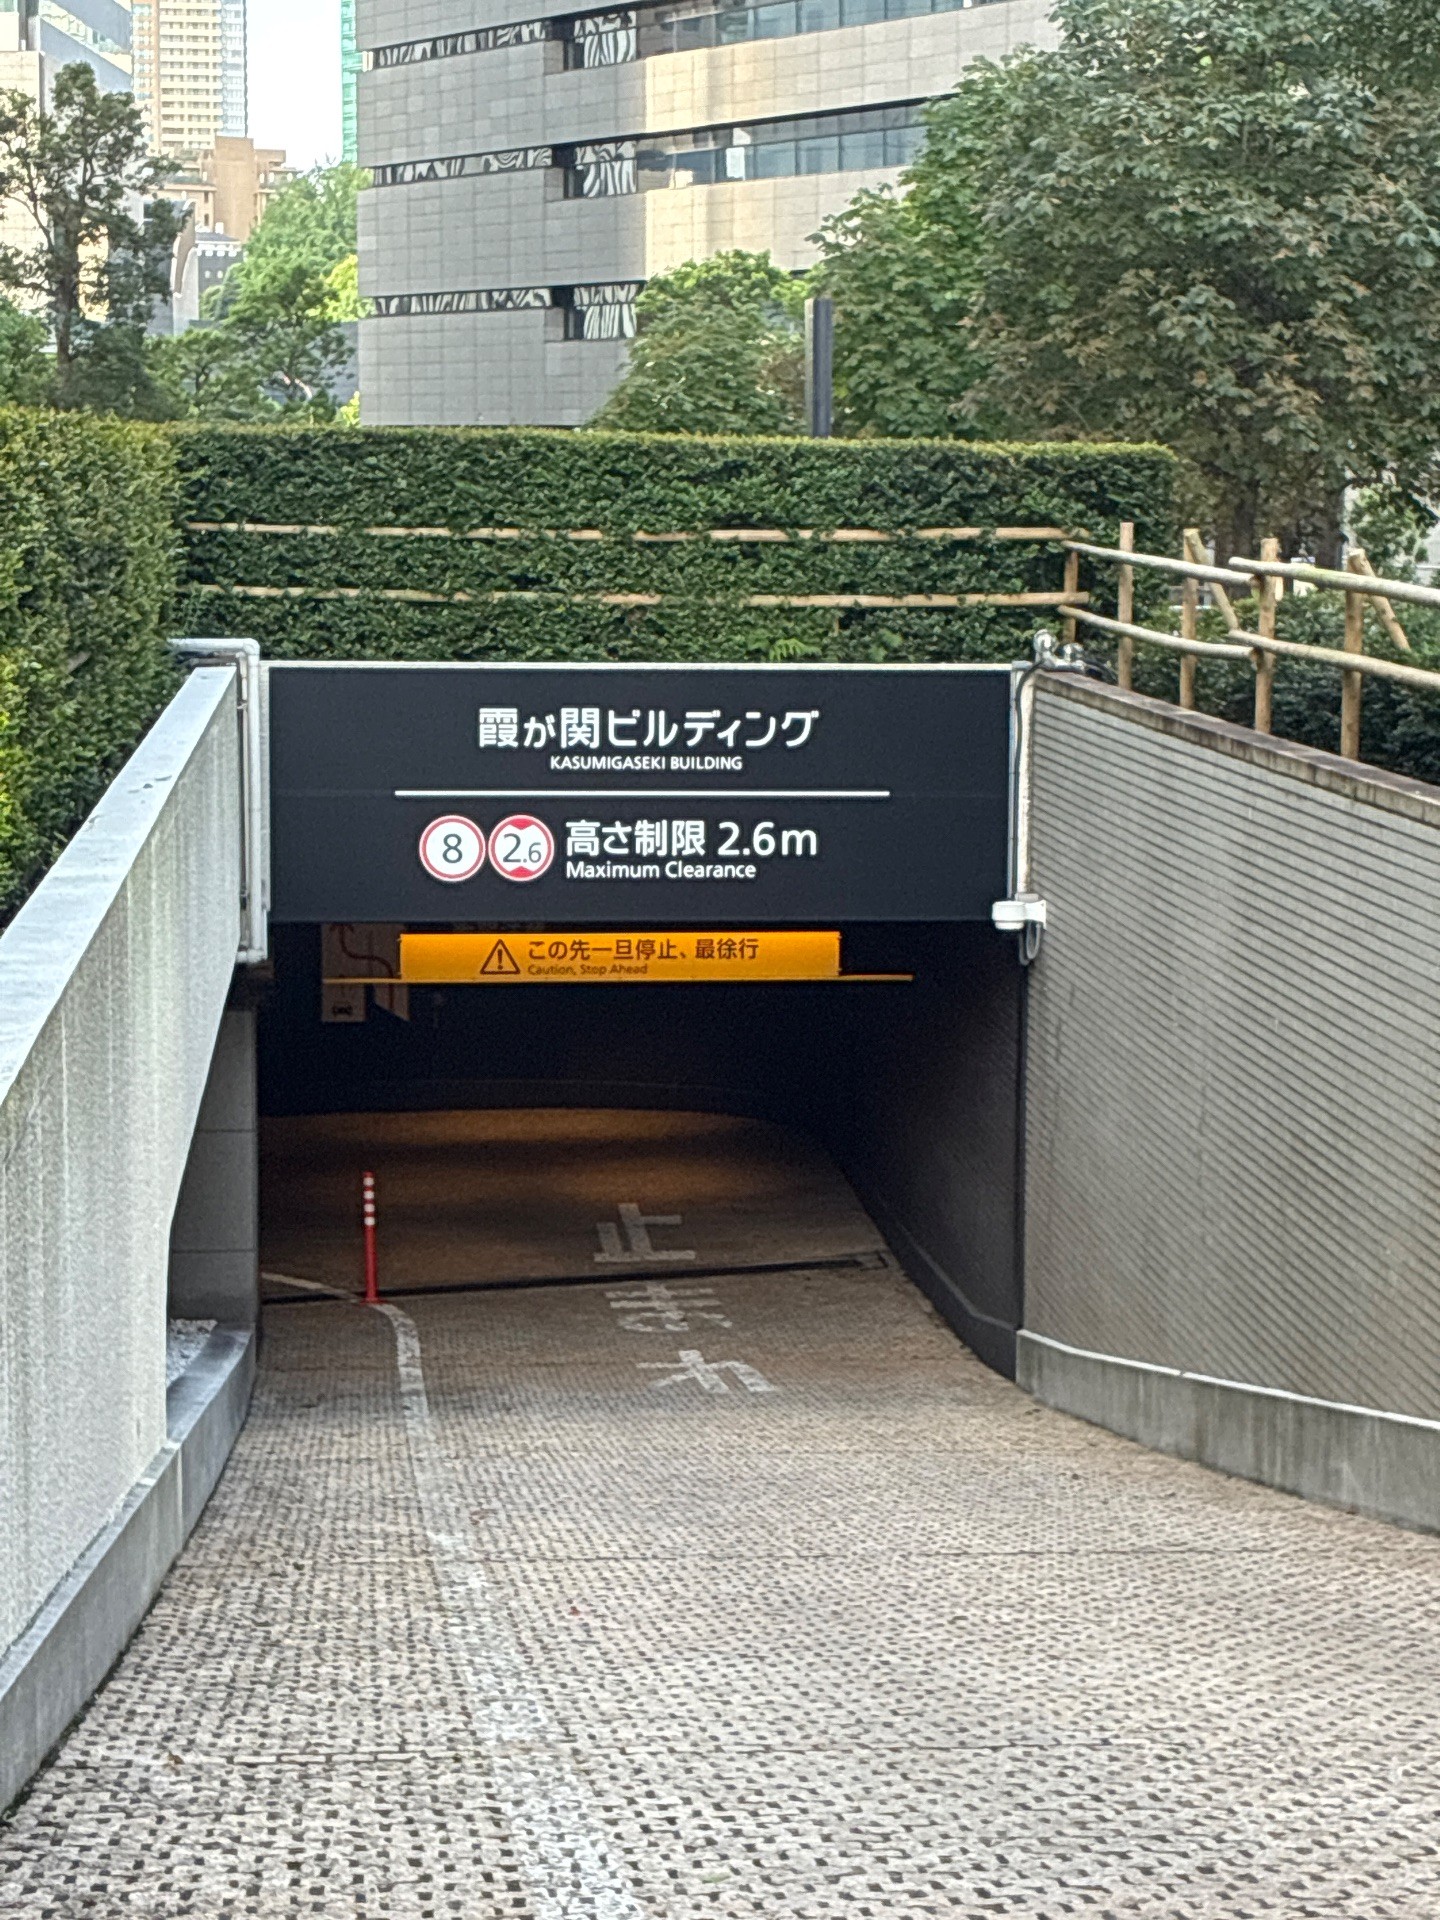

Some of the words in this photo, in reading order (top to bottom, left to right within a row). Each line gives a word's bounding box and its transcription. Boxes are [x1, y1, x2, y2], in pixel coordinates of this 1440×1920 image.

[479, 708, 820, 749] 霞が関ビルディング
[550, 755, 666, 770] KASUMIGASEKI
[670, 755, 742, 770] BUILDING
[442, 833, 463, 864] 8
[503, 833, 542, 864] 2.6
[565, 819, 705, 857] 高さ制限
[717, 821, 818, 856] 2.6m
[566, 861, 660, 879] Maximum
[665, 861, 757, 879] Clearance
[528, 938, 759, 961] この先一旦停止、最徐行
[527, 963, 576, 976] Caution,
[580, 963, 608, 976] Stop
[610, 963, 648, 975] Ahead
[593, 1202, 777, 1395] 止まれ
